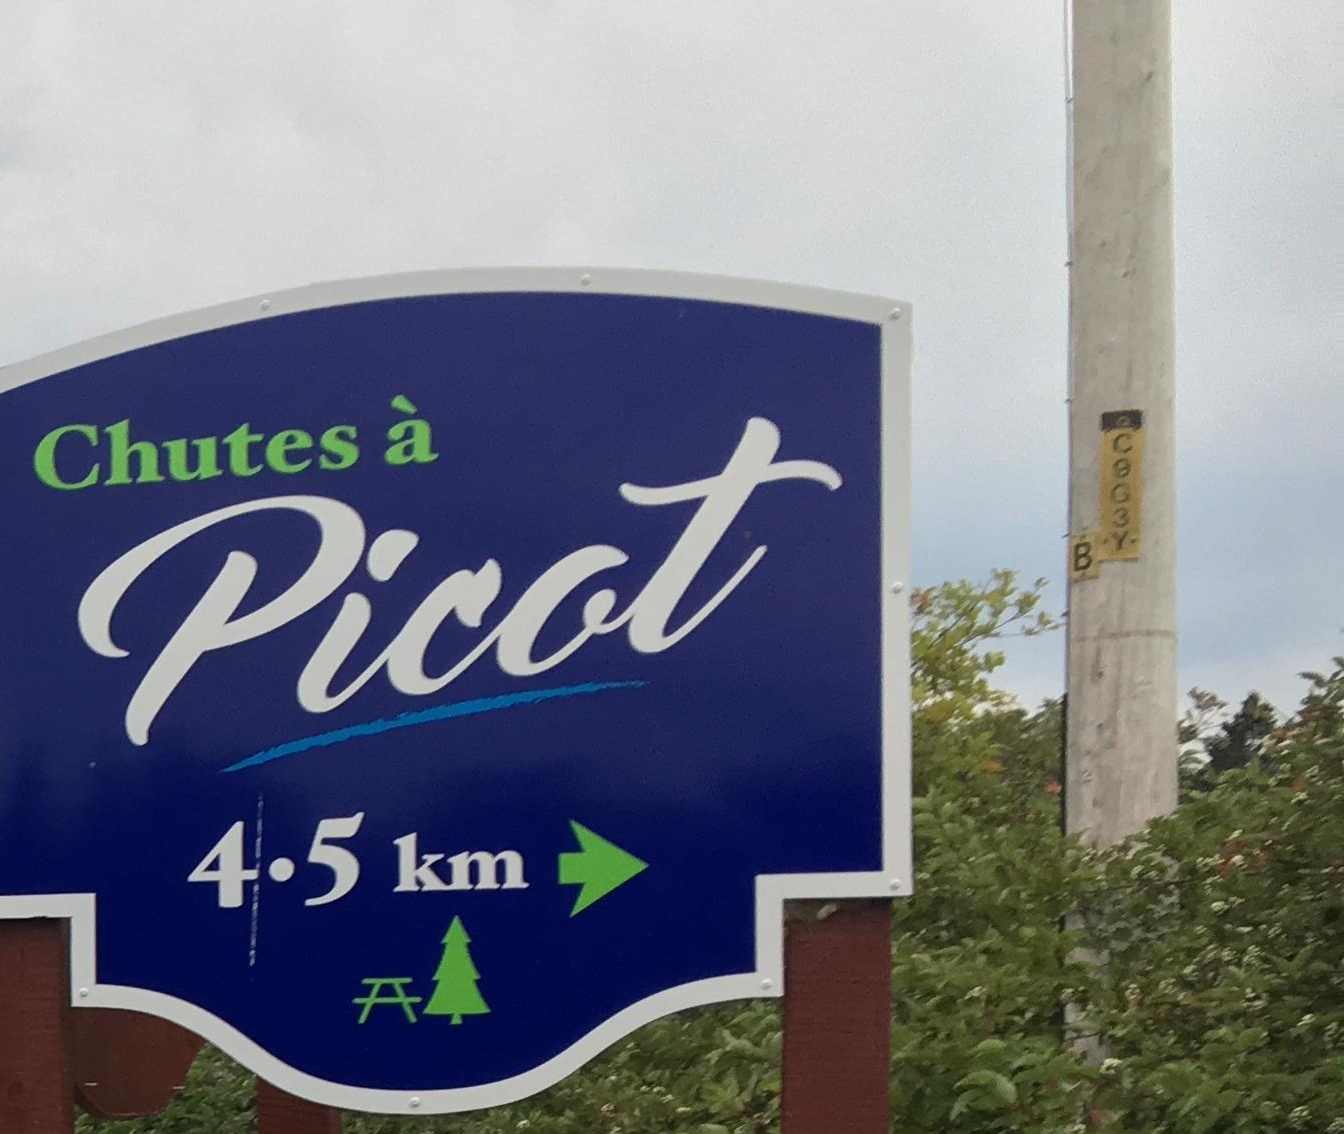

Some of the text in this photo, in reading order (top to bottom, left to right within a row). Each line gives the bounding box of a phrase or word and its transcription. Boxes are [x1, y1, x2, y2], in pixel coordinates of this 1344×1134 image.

[33, 395, 439, 491] Chutes à
[77, 416, 843, 747] Picot
[1073, 541, 1093, 572] B
[392, 832, 530, 894] km
